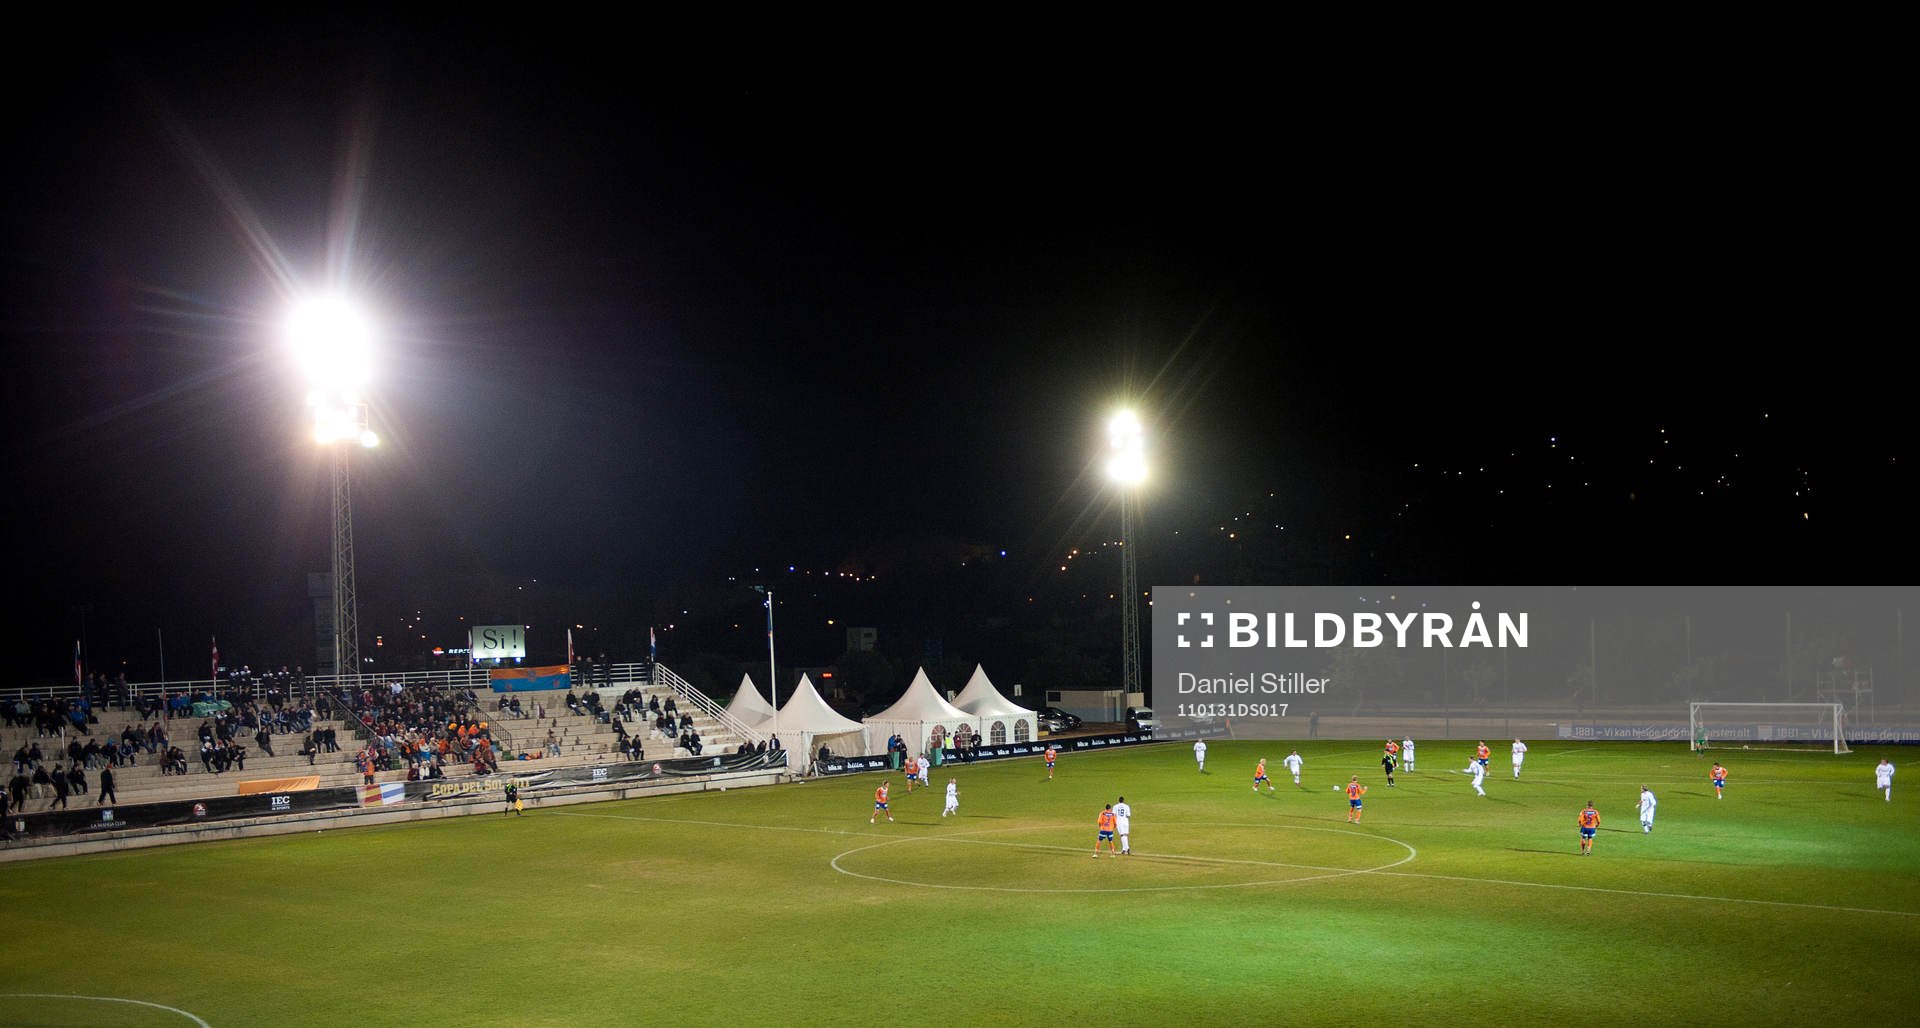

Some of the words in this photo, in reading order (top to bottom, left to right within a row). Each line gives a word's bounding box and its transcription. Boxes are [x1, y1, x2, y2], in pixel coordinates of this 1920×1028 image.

[1575, 727, 1594, 737] 1881
[1605, 727, 1613, 737] Vi
[1615, 727, 1631, 737] kan
[1777, 728, 1799, 738] 1881
[271, 795, 290, 805] IEC
